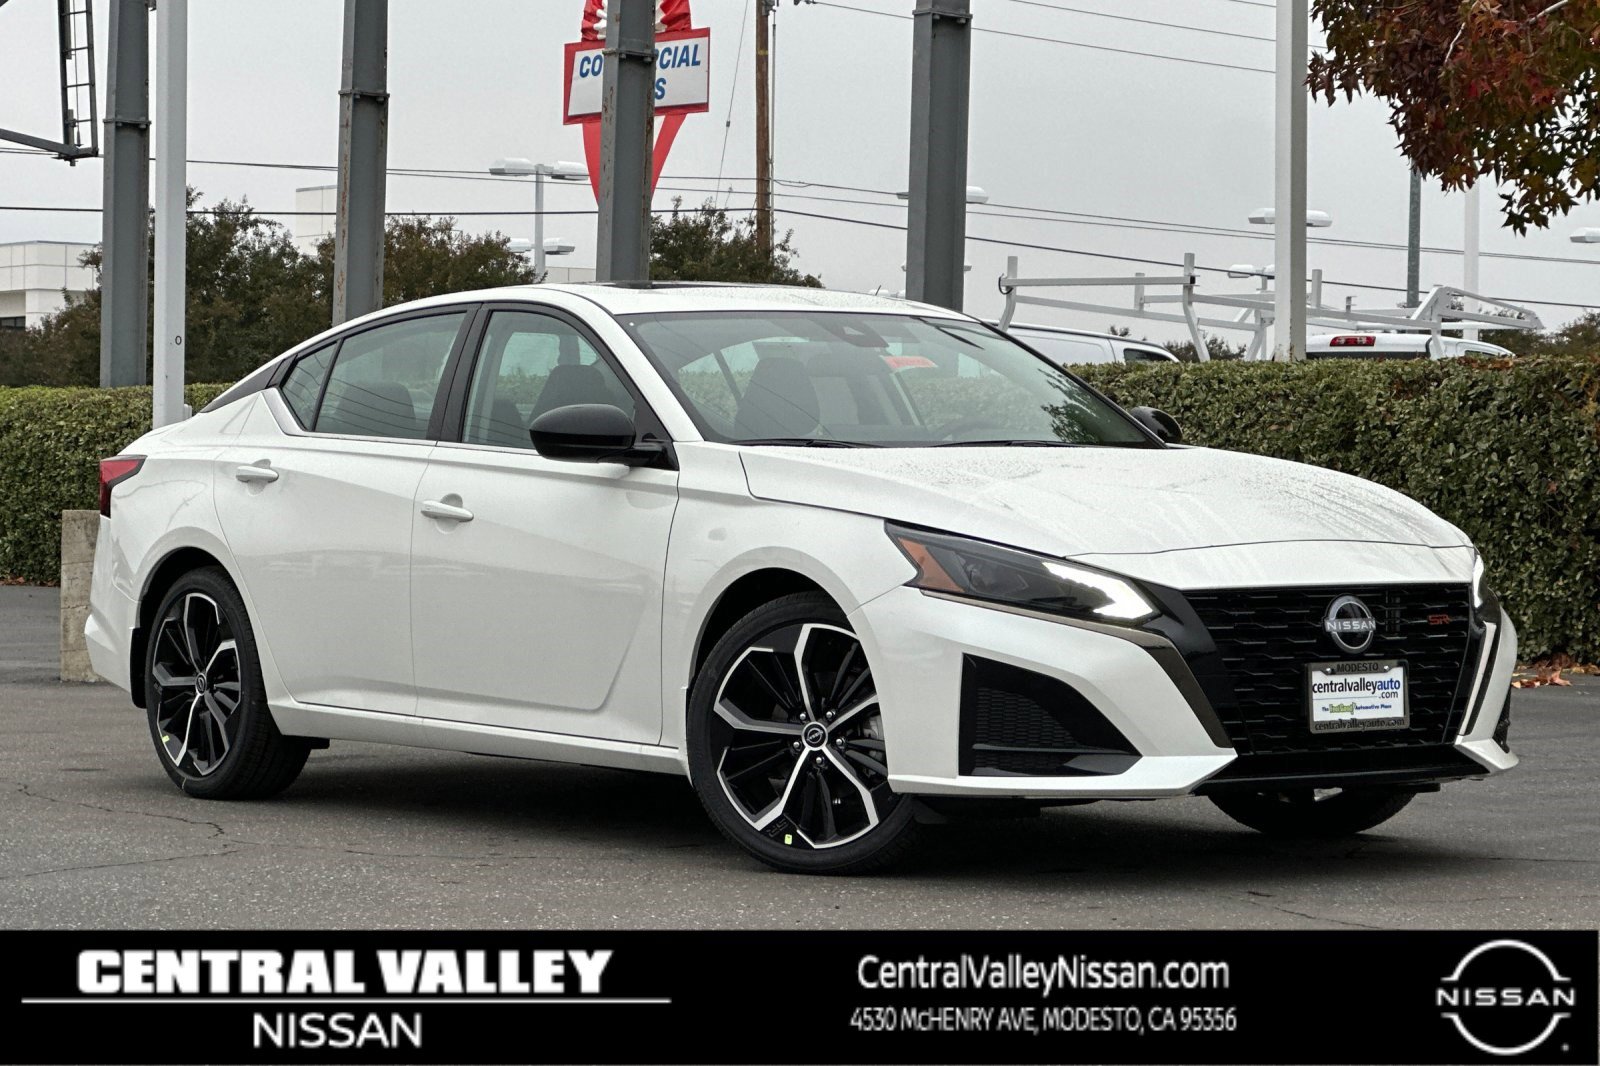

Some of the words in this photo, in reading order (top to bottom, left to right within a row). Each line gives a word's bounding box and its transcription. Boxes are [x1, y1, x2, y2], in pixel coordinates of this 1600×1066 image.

[1427, 614, 1451, 625] SR
[1325, 620, 1376, 631] NISSAN
[1336, 662, 1379, 673] MODESTO
[1312, 677, 1401, 695] centralvalleyauto
[1378, 690, 1399, 699] .com
